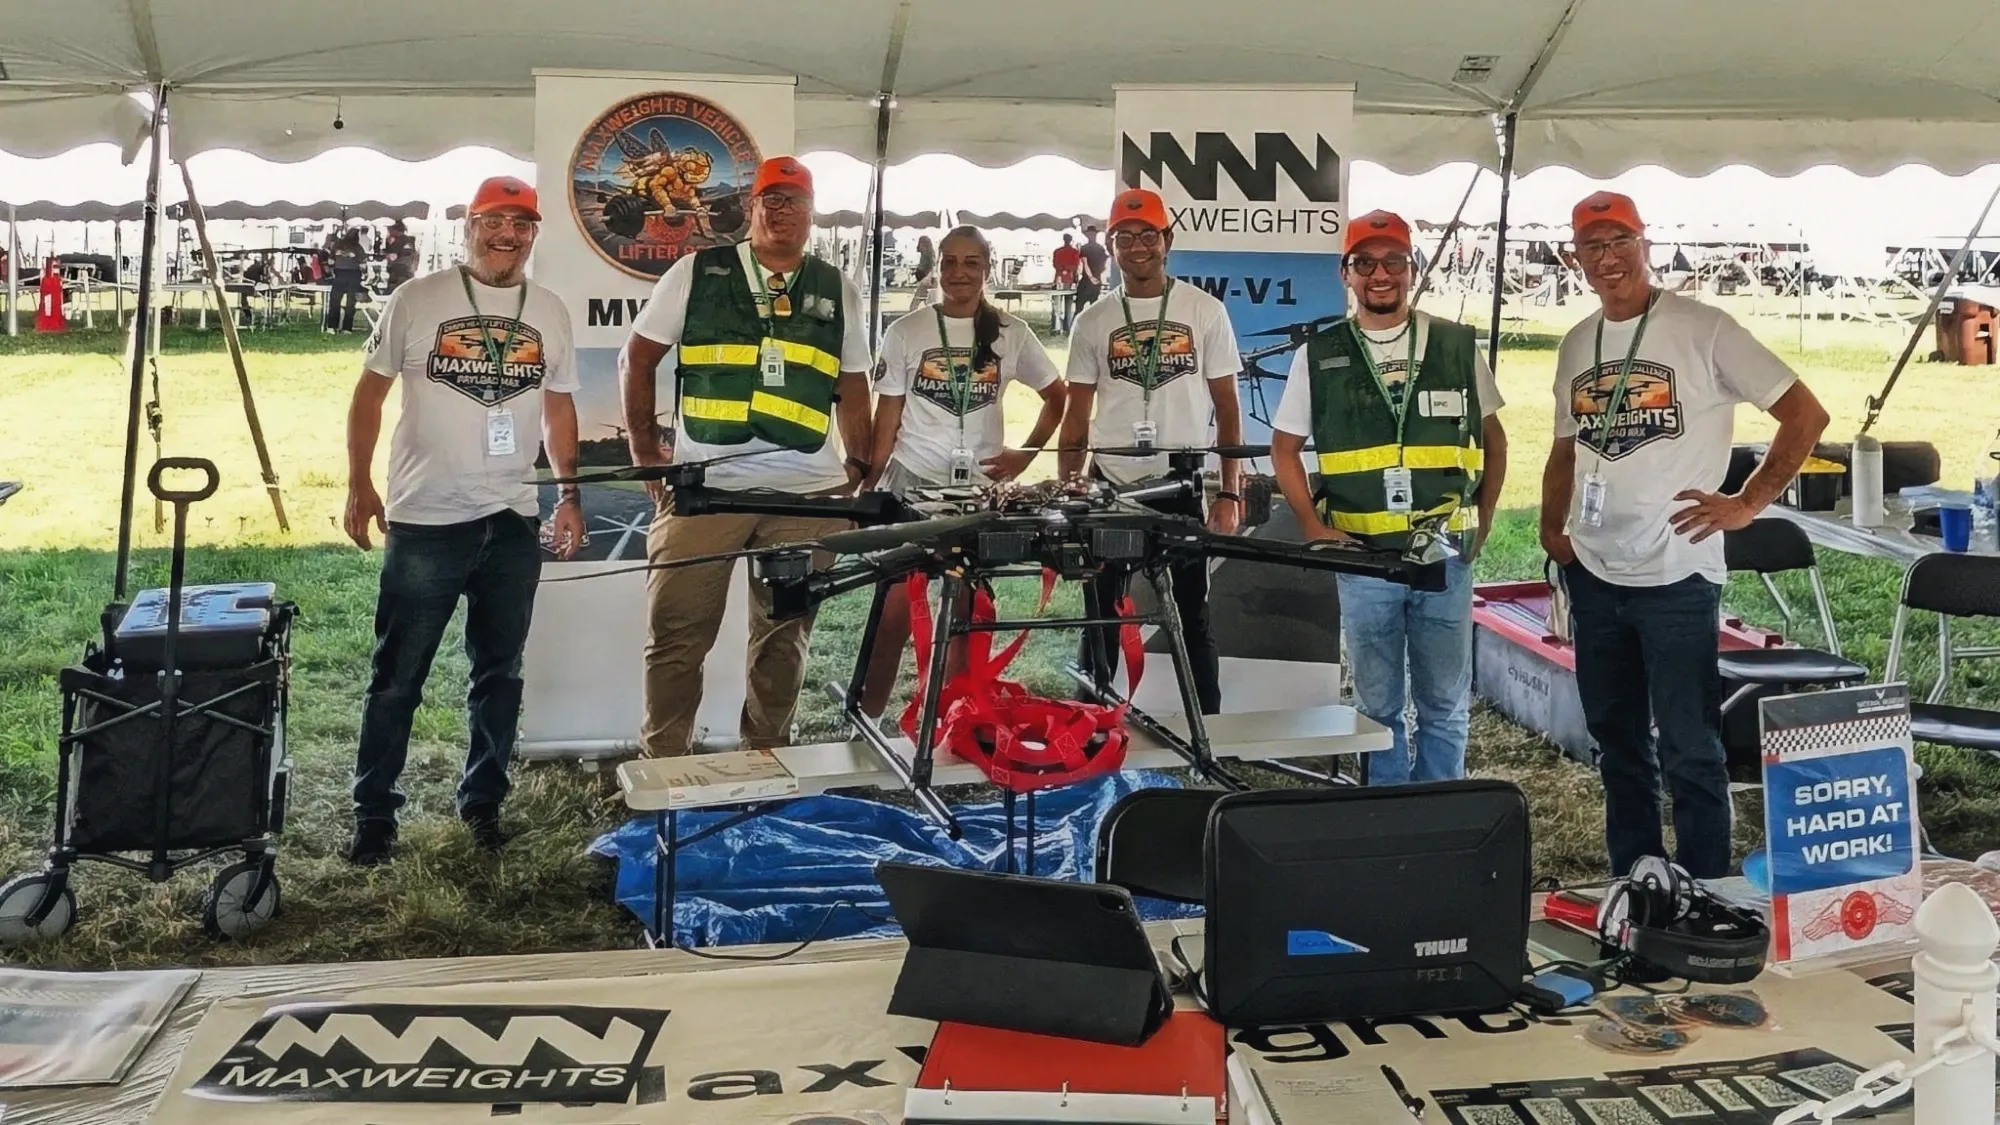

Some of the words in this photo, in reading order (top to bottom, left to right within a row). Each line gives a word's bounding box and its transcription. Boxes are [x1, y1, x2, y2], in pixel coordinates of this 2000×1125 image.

[581, 97, 687, 174] MAXWEIGHTS
[691, 102, 753, 165] VEHICLE
[1168, 207, 1340, 235] XWEIGHTS
[618, 243, 678, 260] LIFTER
[1177, 275, 1298, 305] W-V1
[432, 356, 543, 379] MAXWEGHTS
[1795, 774, 1893, 806] SORRY,
[1787, 808, 1866, 838] HARD
[1870, 802, 1902, 825] AT
[1801, 833, 1893, 865] WORK!
[1414, 938, 1468, 957] THULE
[218, 1064, 628, 1090] MAXWEIGHTS
